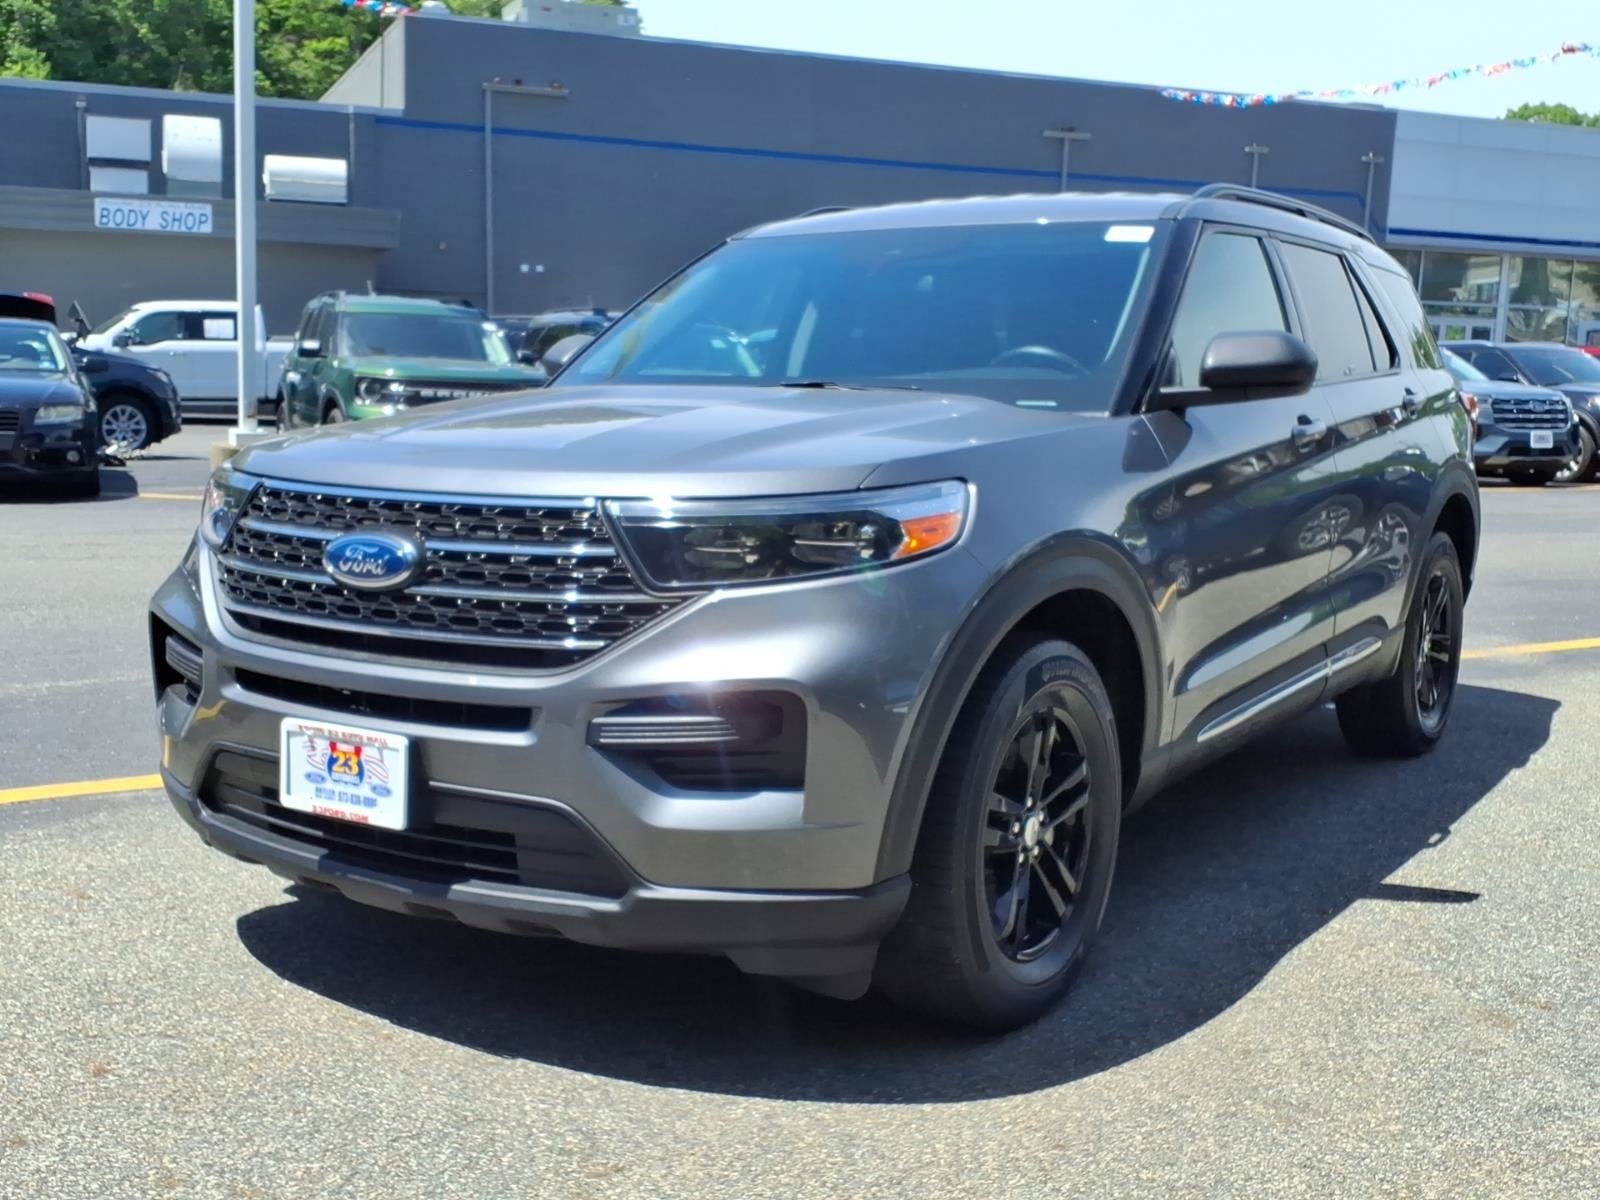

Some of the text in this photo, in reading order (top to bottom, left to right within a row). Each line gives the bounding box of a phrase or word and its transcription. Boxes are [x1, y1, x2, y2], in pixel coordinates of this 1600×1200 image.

[100, 207, 208, 231] BODY SHOP
[339, 544, 390, 575] Ford
[333, 750, 359, 776] 23
